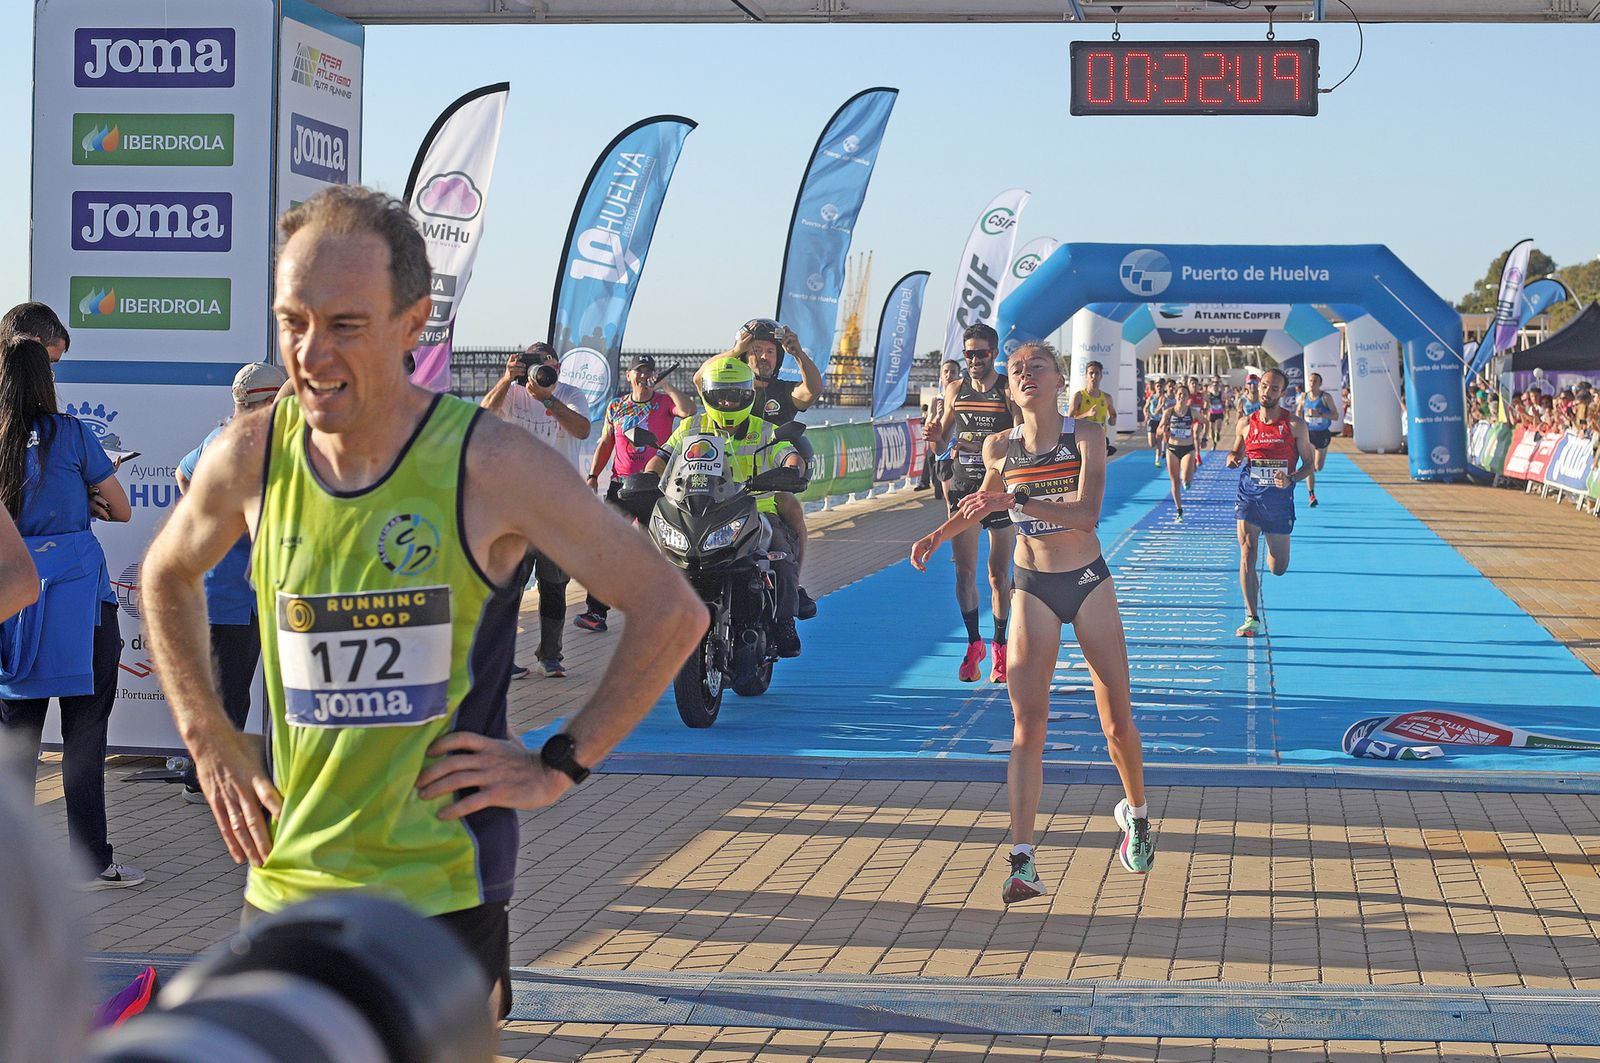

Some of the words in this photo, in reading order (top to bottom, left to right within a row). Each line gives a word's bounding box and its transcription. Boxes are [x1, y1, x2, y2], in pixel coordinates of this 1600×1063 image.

[84, 38, 228, 79] Joma
[315, 68, 352, 88] ATLETISMO
[123, 134, 225, 150] IBERDROLA
[293, 124, 346, 172] Joma
[596, 152, 645, 235] HUELVA
[81, 202, 225, 243] Joma
[987, 214, 1016, 230] CSIF
[422, 221, 470, 244] WiHu
[1018, 260, 1040, 273] CSI
[1182, 265, 1239, 281] Puerto
[1243, 265, 1265, 281] de
[1270, 265, 1329, 281] Huelva
[119, 298, 222, 315] IBERDROLA
[1194, 311, 1241, 320] ATLANTIC
[1243, 311, 1281, 320] COPPER
[1209, 335, 1240, 345] Syrluz
[1054, 454, 1076, 462] adidas
[688, 462, 713, 471] WiHu
[1034, 478, 1075, 488] RUNNING
[1078, 575, 1100, 586] adidas
[327, 592, 427, 612] RUNNING
[352, 612, 411, 628] LOOP
[310, 636, 404, 683] 172
[122, 689, 165, 701] Portuaria
[314, 689, 413, 721] Joma
